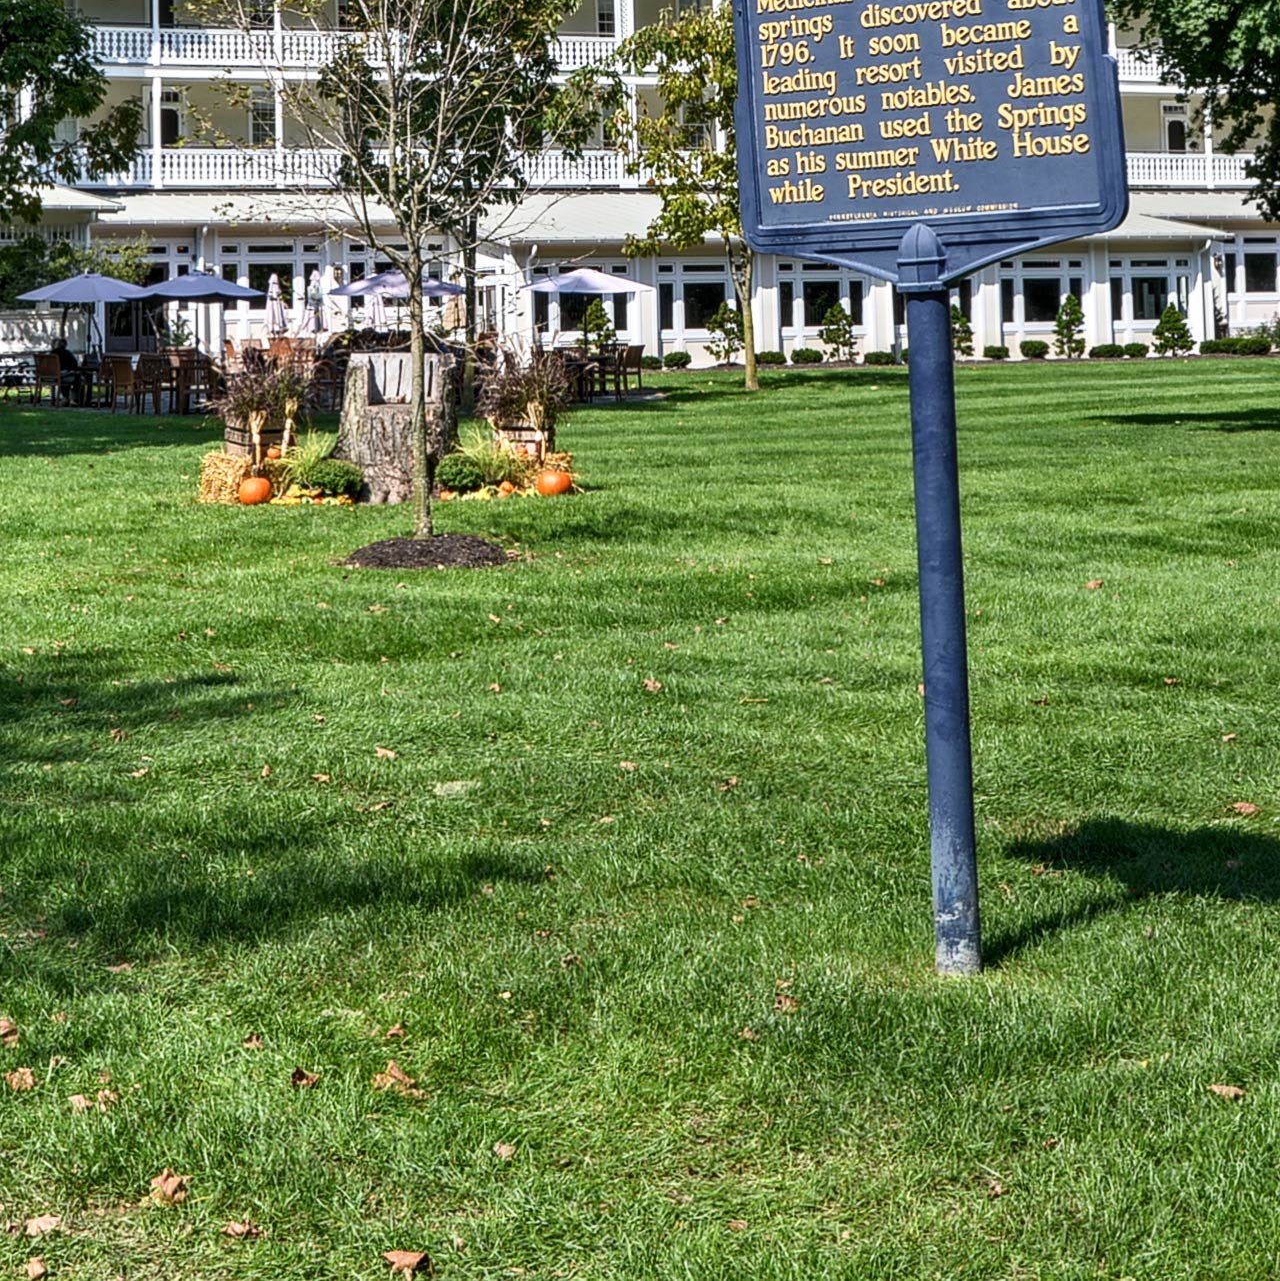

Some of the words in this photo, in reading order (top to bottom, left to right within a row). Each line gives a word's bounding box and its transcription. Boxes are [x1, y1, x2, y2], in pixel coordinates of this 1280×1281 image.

[758, 15, 833, 47] springs
[761, 41, 816, 67] 1796.
[839, 36, 854, 58] It
[870, 34, 921, 55] soon
[941, 20, 1031, 47] became
[1064, 15, 1079, 33] a
[762, 70, 836, 96] leading
[856, 58, 921, 85] resort
[944, 46, 1025, 74] visited
[1050, 42, 1080, 69] by
[765, 95, 866, 121] numerous
[882, 81, 976, 110] notables.
[1007, 73, 1084, 98] James
[766, 124, 865, 149] Buchanan
[879, 113, 931, 139] used
[946, 108, 982, 132] the
[997, 102, 1087, 133] Springs
[767, 158, 790, 176] as
[796, 152, 826, 174] his
[837, 147, 919, 170] summer
[931, 138, 998, 162] White
[1011, 131, 1091, 159] House
[769, 179, 825, 203] while
[847, 171, 960, 198] President.
